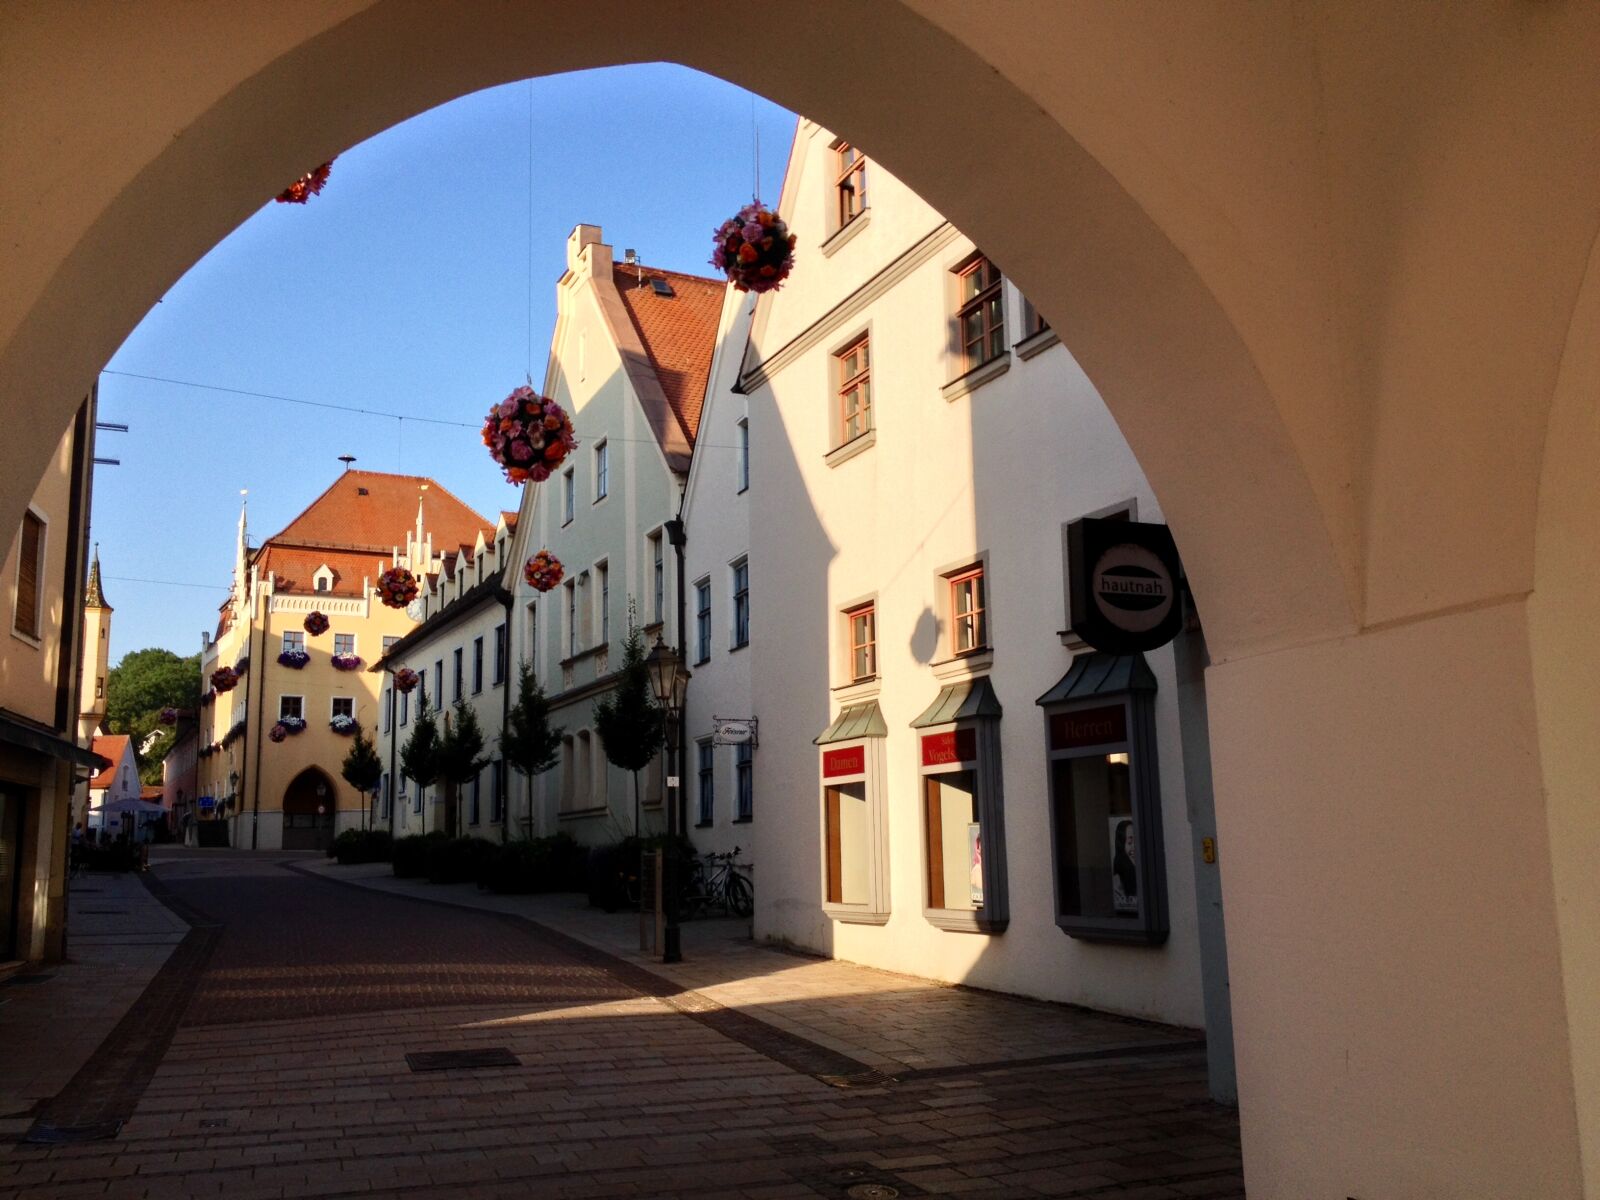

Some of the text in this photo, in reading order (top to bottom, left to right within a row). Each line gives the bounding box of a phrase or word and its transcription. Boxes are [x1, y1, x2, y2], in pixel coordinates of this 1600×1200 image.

[1101, 577, 1164, 594] hautnah
[1064, 719, 1113, 740] Herren
[830, 756, 858, 771] Damen
